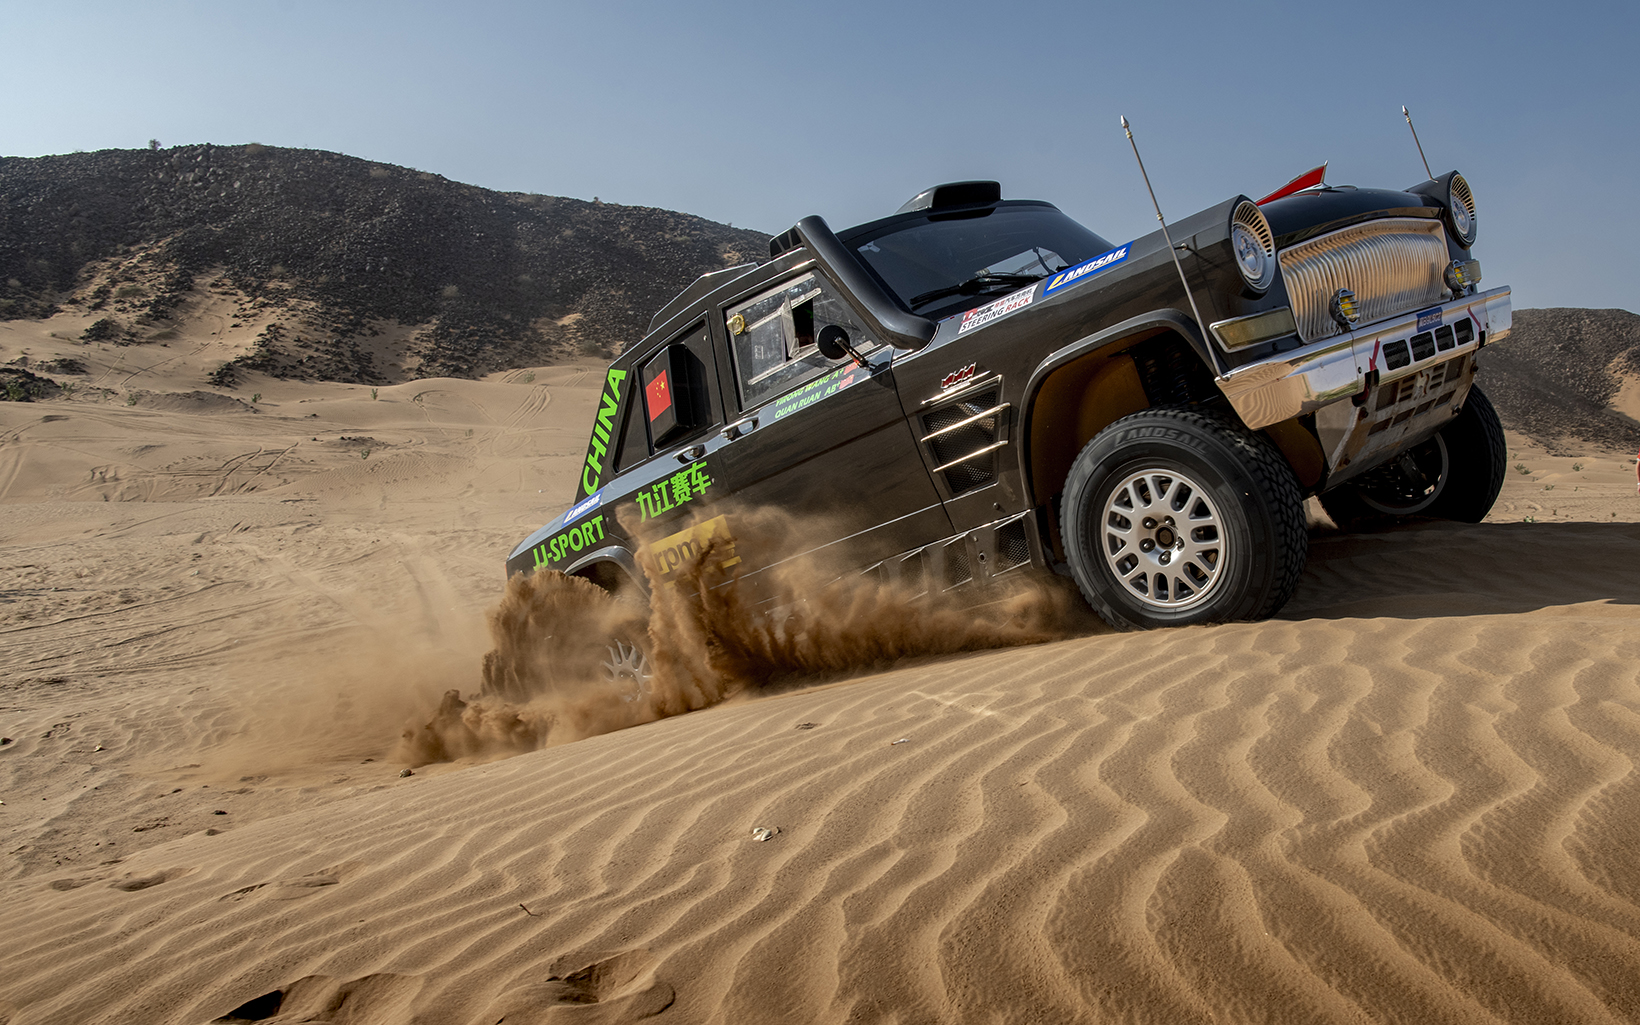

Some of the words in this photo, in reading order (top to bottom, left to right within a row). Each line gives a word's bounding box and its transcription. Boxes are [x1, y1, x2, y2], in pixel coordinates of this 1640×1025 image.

[1047, 247, 1127, 291] LANDSAIL
[961, 308, 1004, 331] STEERING
[1005, 296, 1031, 313] RACK
[798, 391, 821, 409] RUAN
[583, 369, 627, 496] CHINA
[1114, 426, 1208, 455] LANDSAIL
[635, 461, 712, 523] 九江赛车
[533, 515, 605, 572] JJ-SPORT
